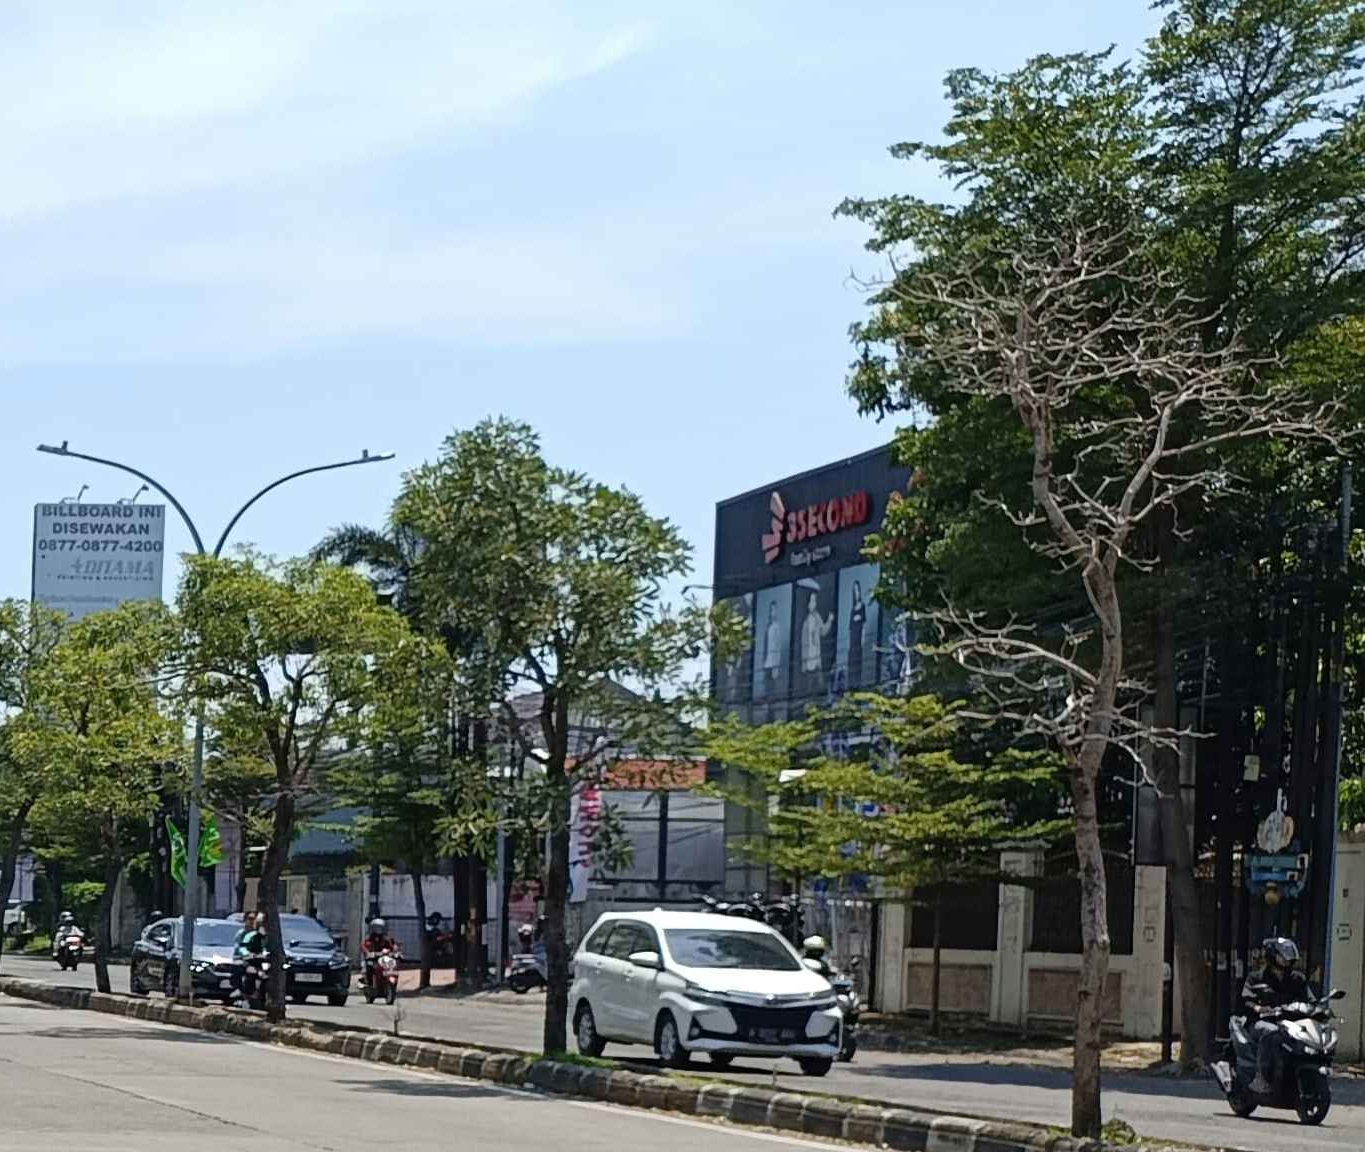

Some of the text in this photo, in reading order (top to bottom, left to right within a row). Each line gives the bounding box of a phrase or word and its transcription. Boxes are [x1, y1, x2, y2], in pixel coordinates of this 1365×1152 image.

[42, 504, 161, 518] BILLBOARD INI
[786, 489, 869, 543] 3SECOND
[52, 522, 150, 535] DISEWAKAN
[38, 539, 163, 552] 0877-0877-4200
